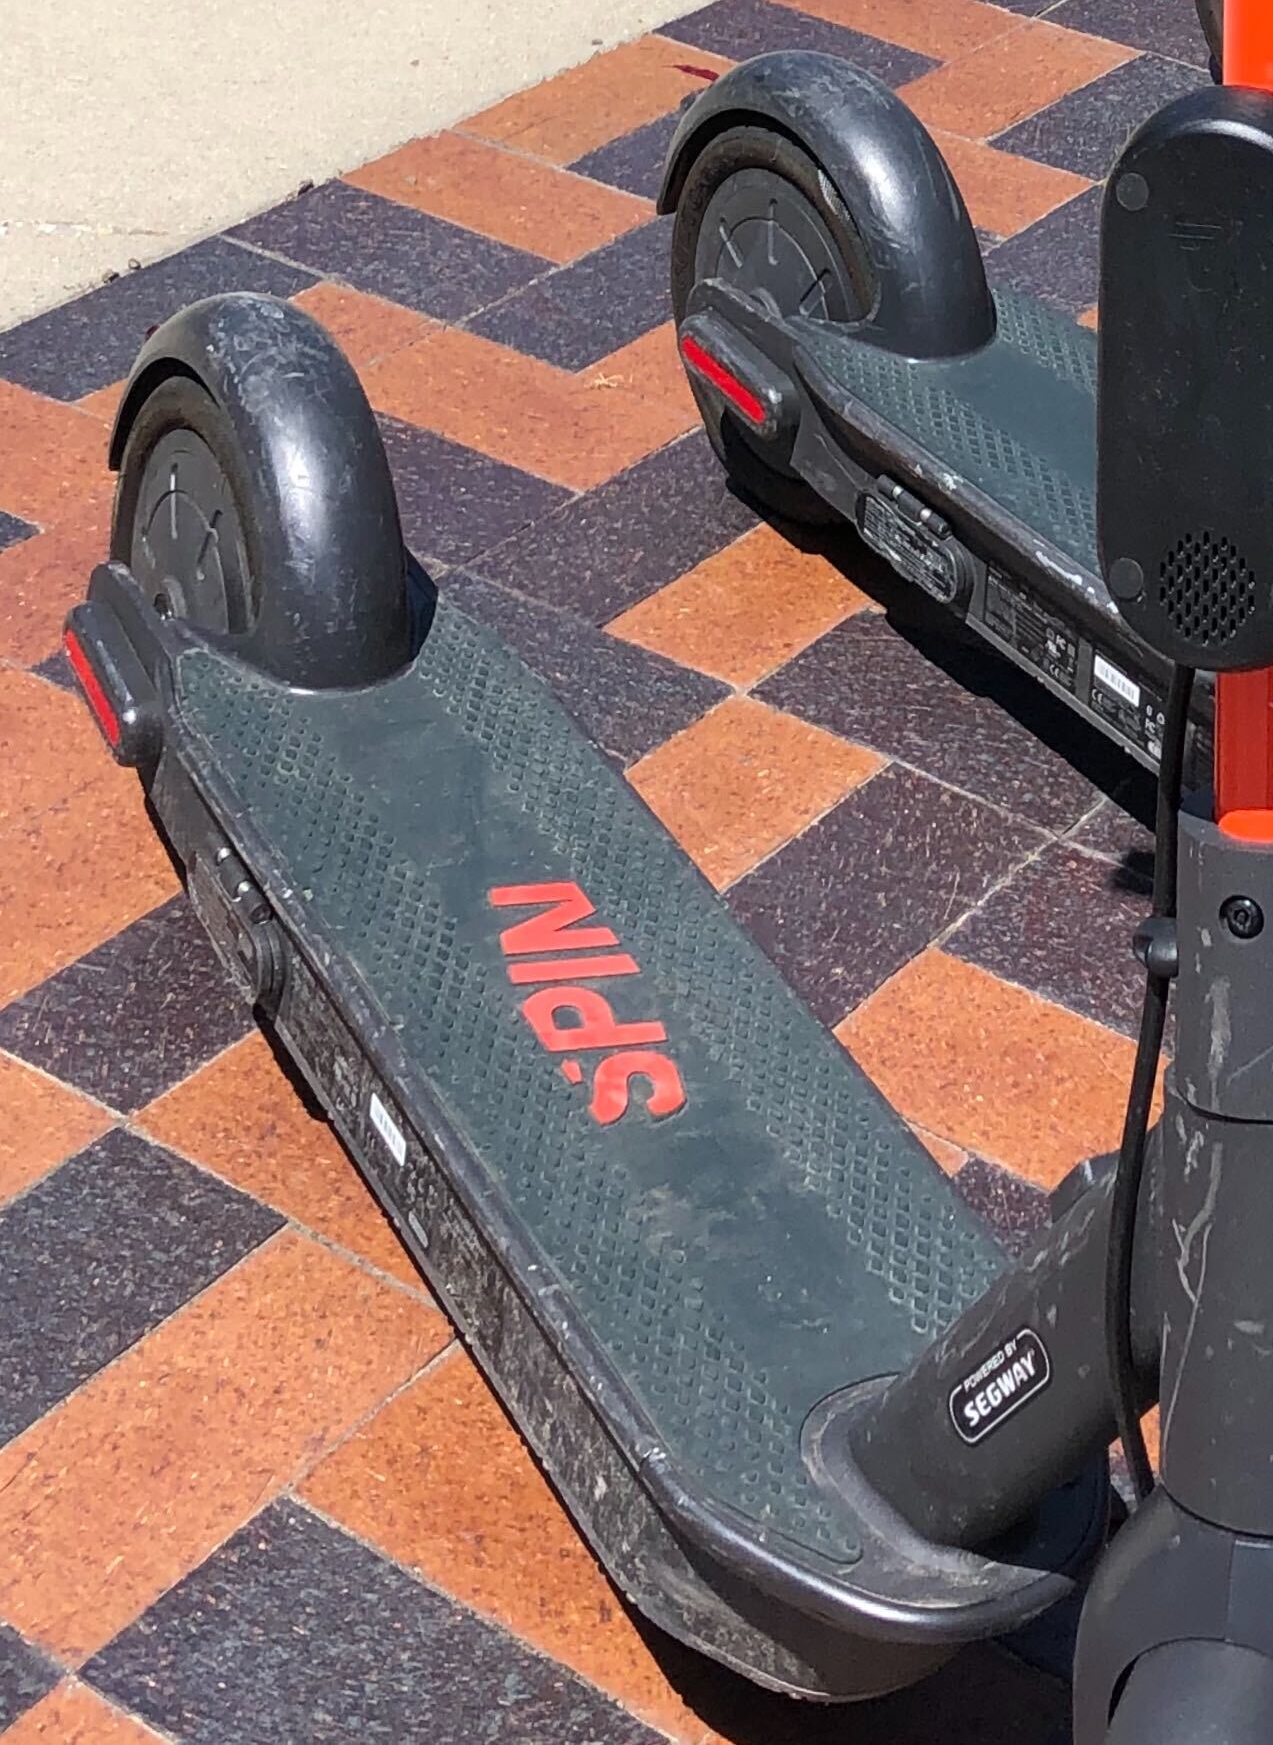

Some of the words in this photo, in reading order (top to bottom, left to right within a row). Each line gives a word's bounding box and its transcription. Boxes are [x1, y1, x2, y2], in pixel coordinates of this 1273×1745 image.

[489, 880, 688, 1126] SPIN
[963, 1350, 1004, 1392] POWERED
[1004, 1338, 1017, 1358] BY
[964, 1350, 1036, 1427] SEGWAY
